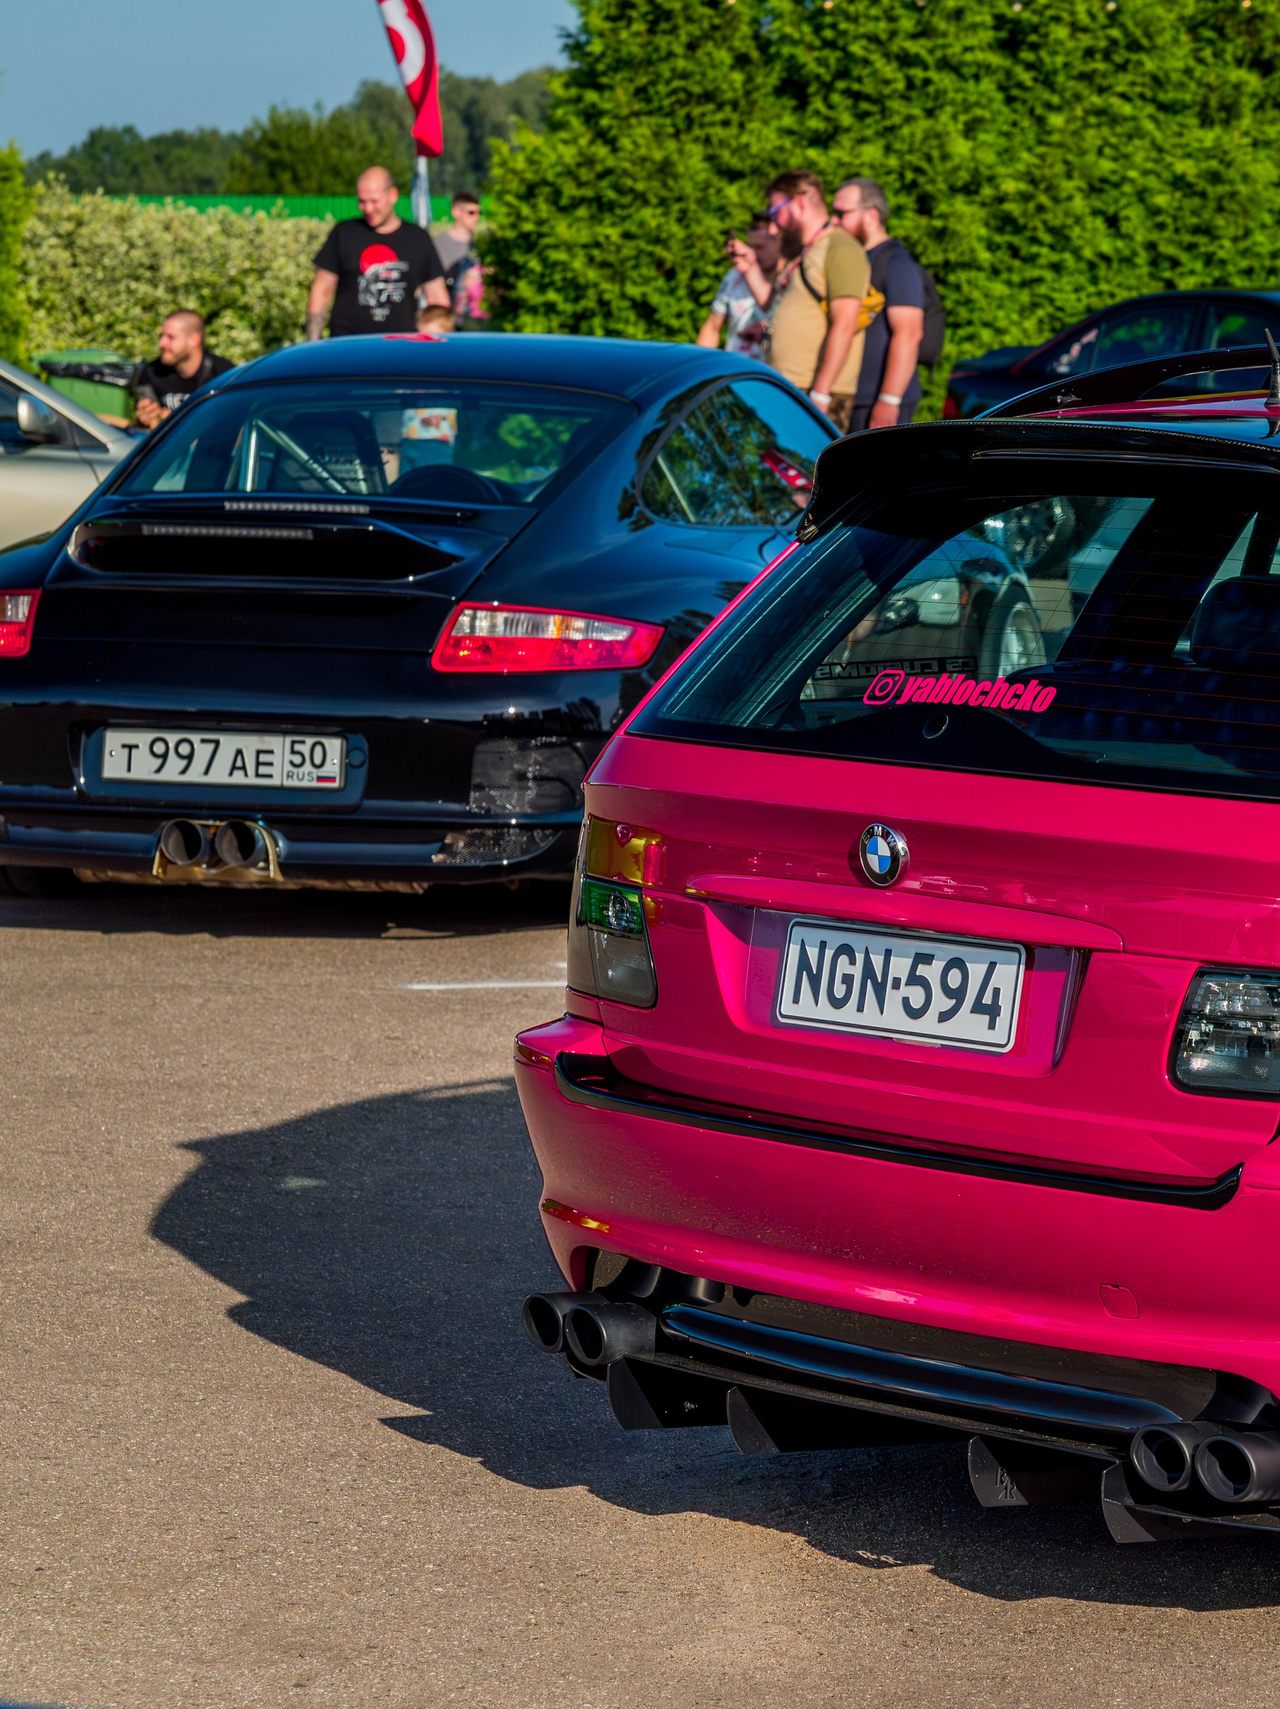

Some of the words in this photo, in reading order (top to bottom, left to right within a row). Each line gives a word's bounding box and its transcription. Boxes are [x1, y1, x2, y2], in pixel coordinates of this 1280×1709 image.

[896, 673, 1057, 712] yablochcko
[289, 740, 326, 769] 50
[286, 771, 314, 782] RUS
[792, 938, 1002, 1030] NGN-594
